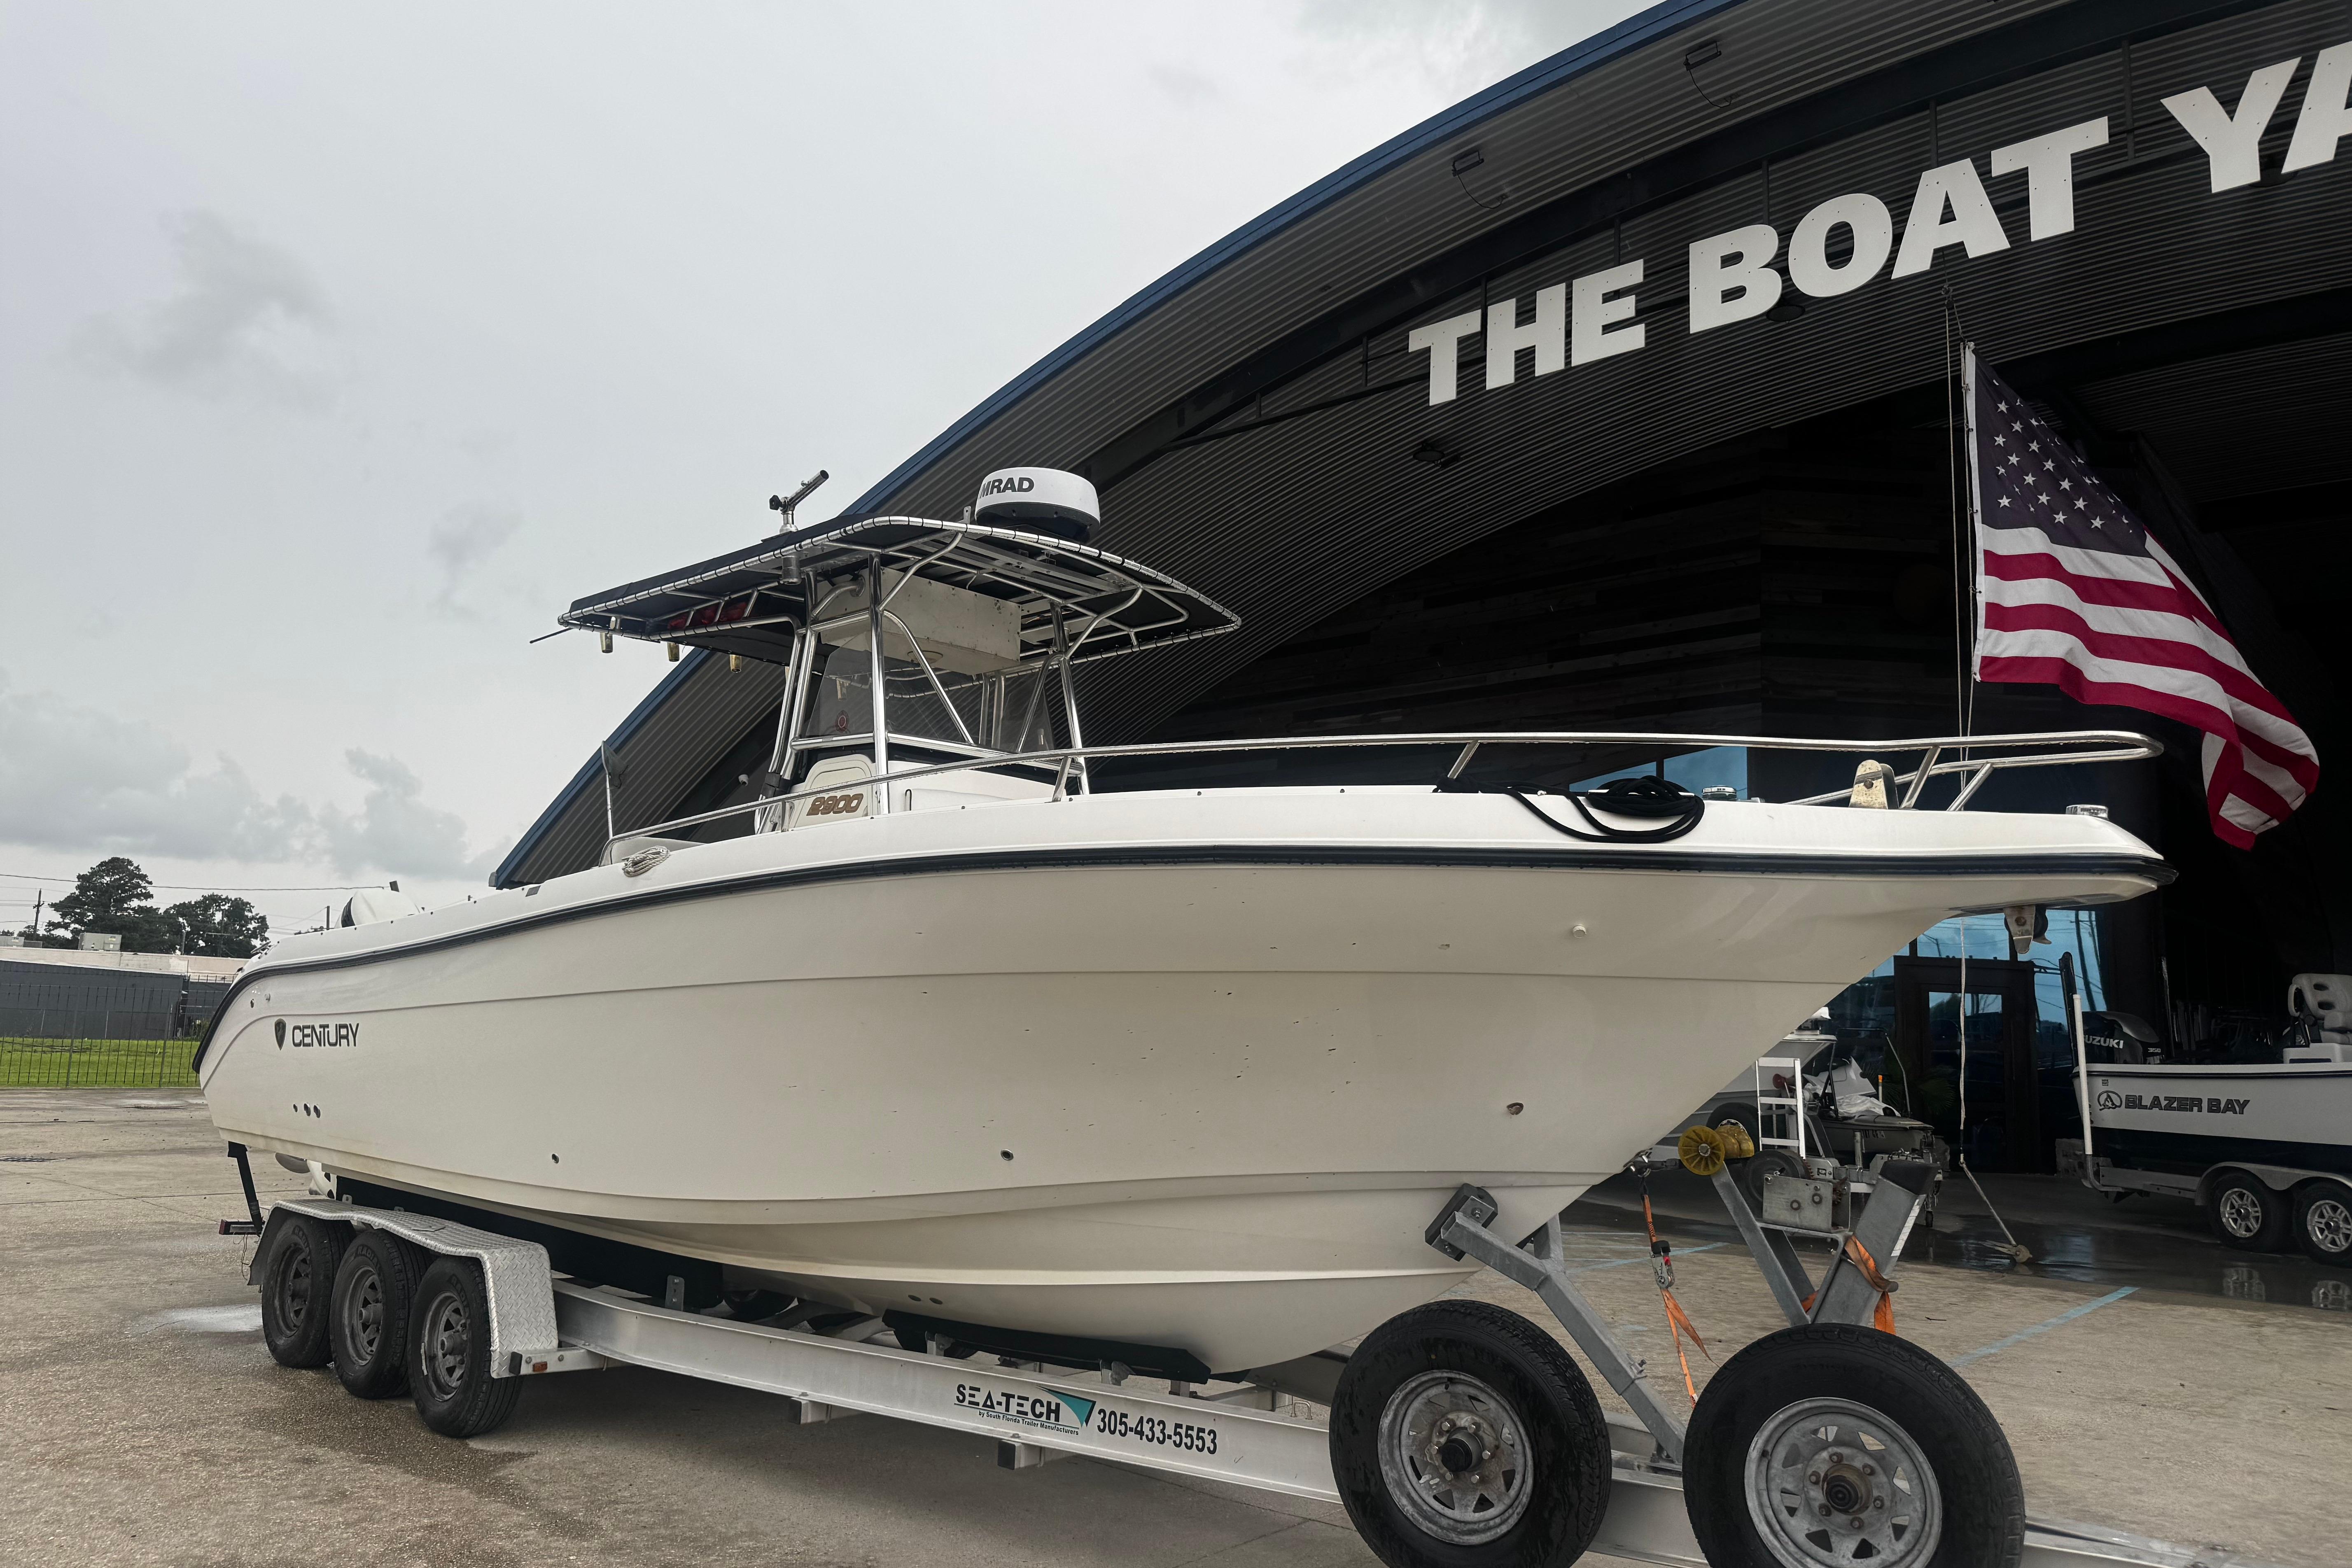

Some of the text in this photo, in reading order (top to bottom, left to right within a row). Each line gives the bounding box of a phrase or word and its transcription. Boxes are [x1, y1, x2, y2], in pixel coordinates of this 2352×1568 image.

[1409, 260, 1646, 406] THE
[1689, 116, 2109, 334] BOAT
[806, 793, 864, 816] 2900
[292, 1023, 359, 1047] CENTURY
[2084, 1035, 2124, 1049] UZUKI
[2125, 1095, 2250, 1115] BLAZER BAY
[956, 1384, 1060, 1422] SEA-TECH
[1002, 1415, 1020, 1423] Florida
[1022, 1419, 1038, 1427] Trailer
[1040, 1423, 1078, 1435] Manufacturers
[1097, 1409, 1217, 1454] 305-433-5553
